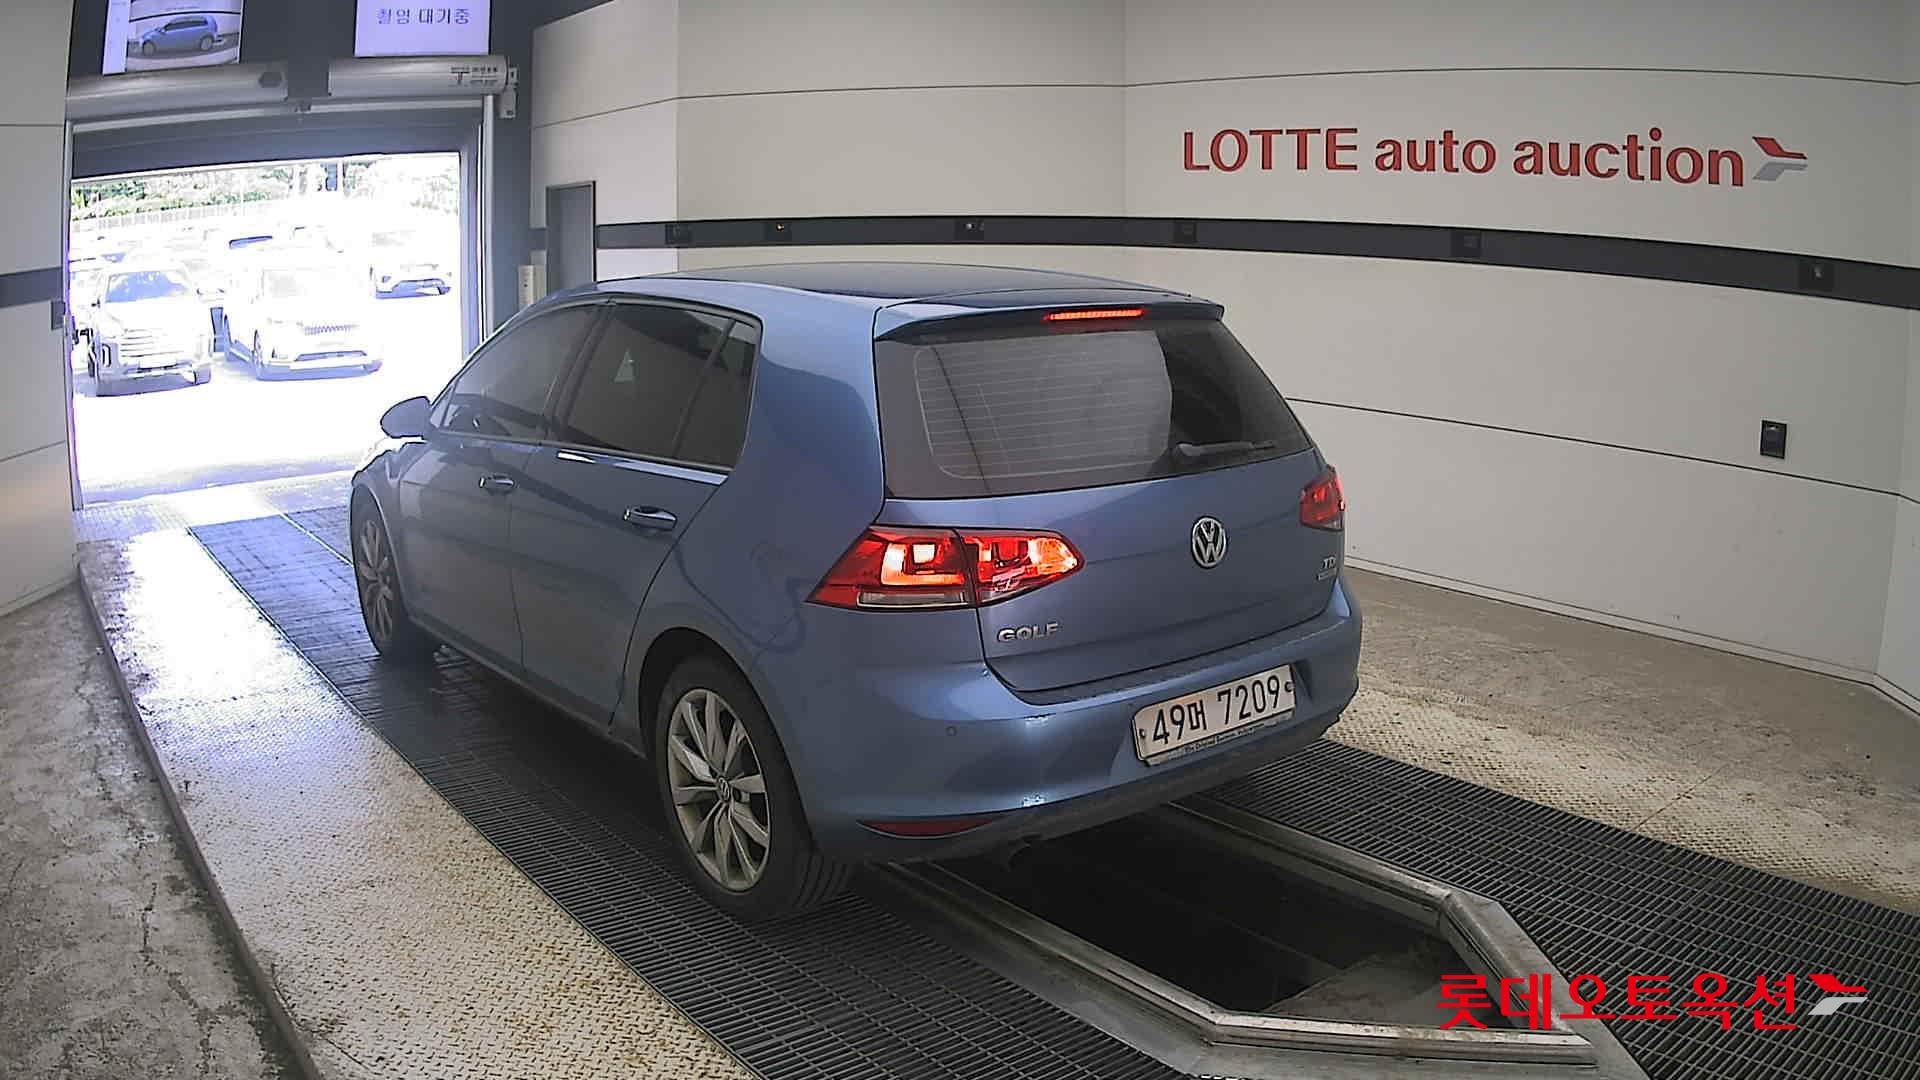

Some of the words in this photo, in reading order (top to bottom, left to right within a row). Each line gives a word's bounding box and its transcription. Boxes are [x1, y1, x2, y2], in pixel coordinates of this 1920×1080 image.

[419, 8, 470, 24] 대기중
[1184, 128, 1358, 173] LOTTE
[1376, 131, 1497, 173] auto
[1514, 128, 1744, 187] auction
[997, 622, 1059, 642] GOLF
[1153, 699, 1208, 744] 49머
[1217, 675, 1280, 726] 7209
